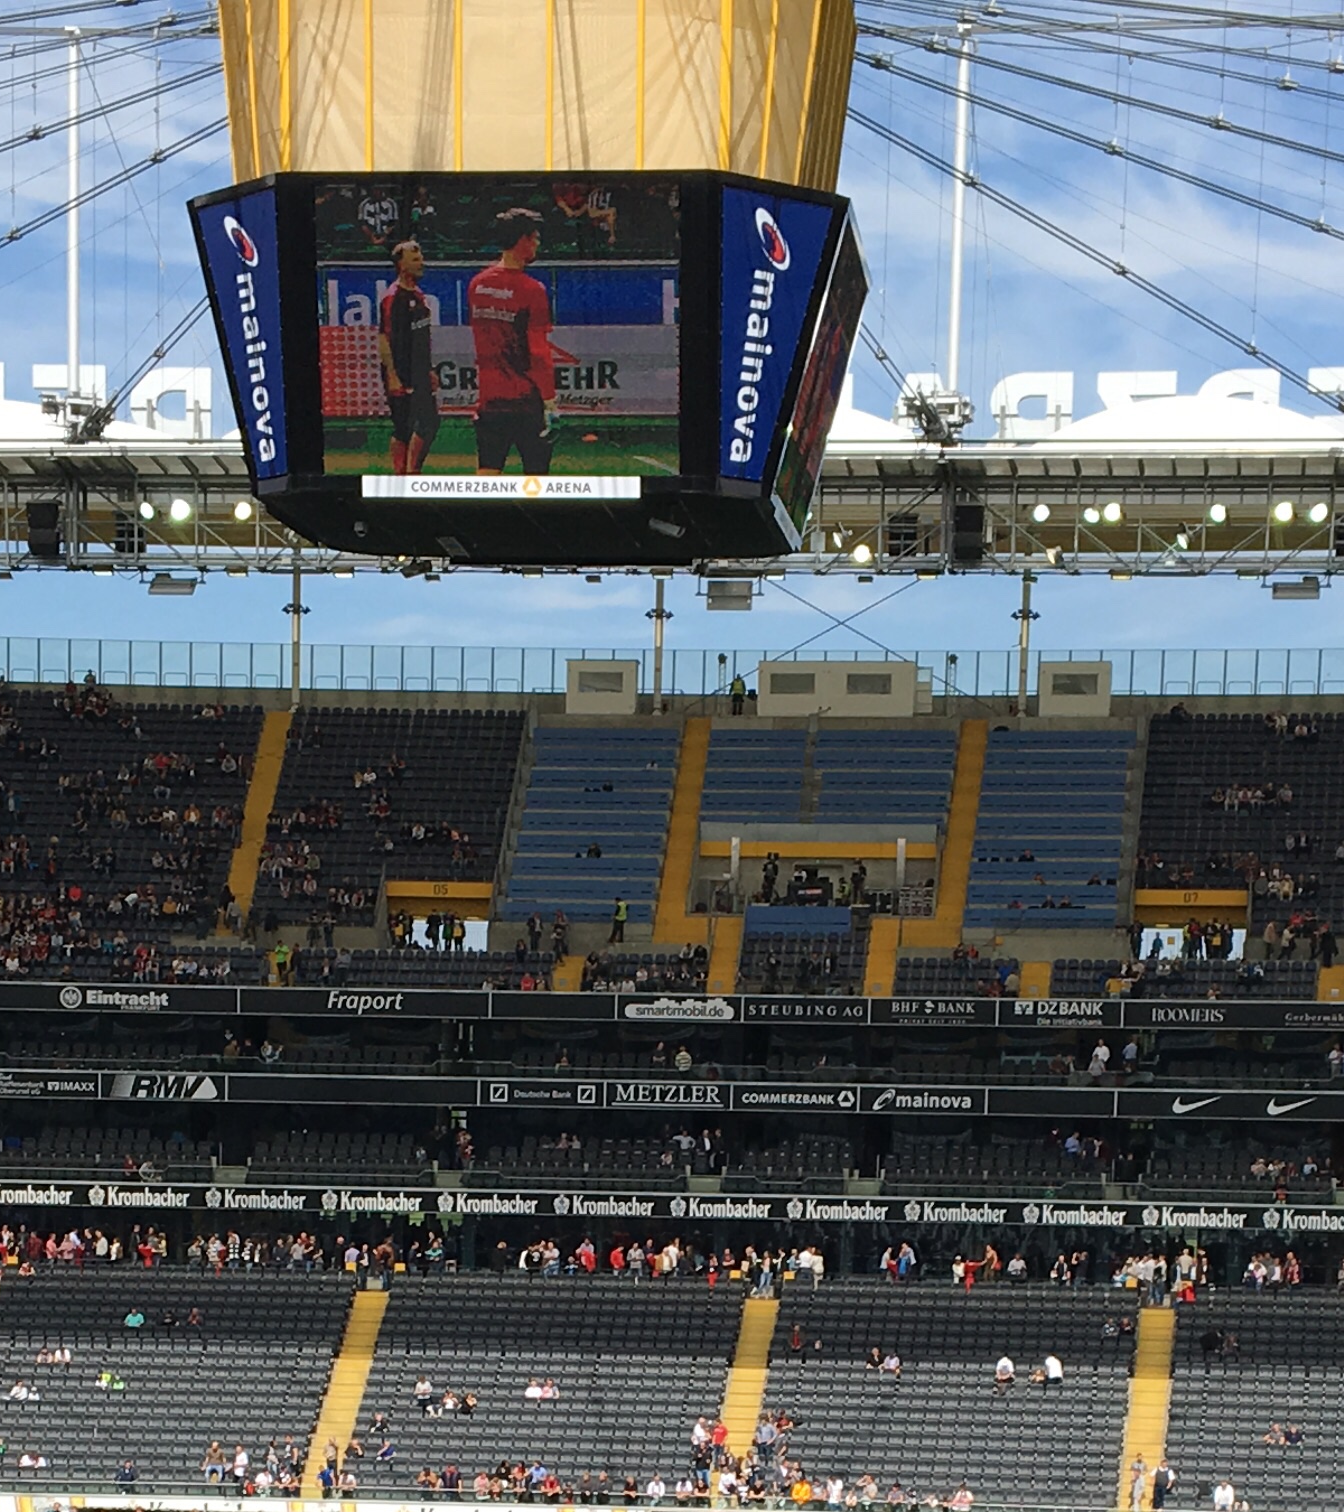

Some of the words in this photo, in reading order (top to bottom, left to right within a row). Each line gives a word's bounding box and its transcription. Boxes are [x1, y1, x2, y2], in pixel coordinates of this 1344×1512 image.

[235, 270, 278, 464] mainova
[729, 269, 780, 465] mainova
[411, 481, 517, 493] COMMERZBANK
[546, 482, 592, 494] ARENA
[86, 989, 170, 1007] Eintracht
[327, 990, 404, 1015] Fraport
[891, 1001, 920, 1014] BHF
[937, 1002, 975, 1014] BANK
[635, 1004, 725, 1018] smartmobil.de
[748, 1004, 838, 1017] STEUBING
[842, 1006, 864, 1017] AG
[1151, 1008, 1224, 1022] ROOMERS
[615, 1084, 720, 1103] METZLER
[742, 1093, 835, 1105] COMMERZBANK
[895, 1094, 972, 1109] mainova
[108, 1186, 191, 1207] Krombacher
[224, 1188, 307, 1209] Krombacher
[340, 1191, 423, 1212] Krombacher
[457, 1193, 539, 1214] Krombacher
[573, 1195, 655, 1216] Krombacher
[689, 1197, 772, 1218] Krombacher
[805, 1199, 889, 1221] Krombacher
[923, 1202, 1007, 1224] Krombacher
[1042, 1204, 1127, 1226] Krombacher
[1161, 1206, 1248, 1228] Krombacher
